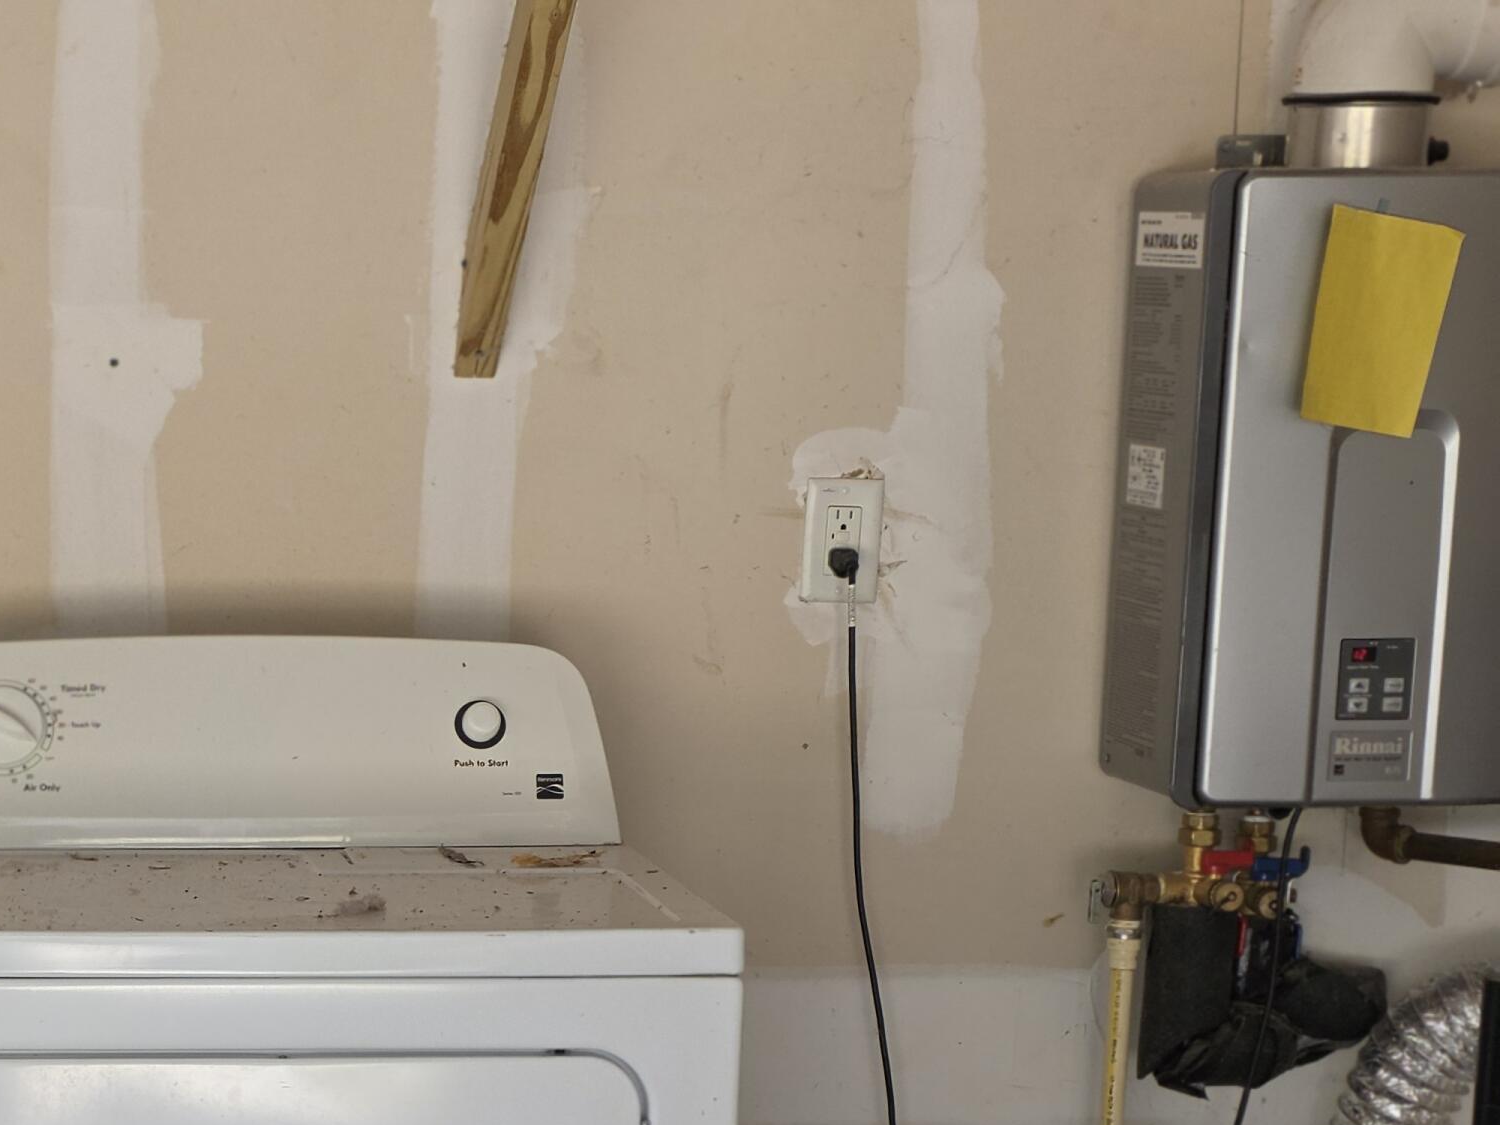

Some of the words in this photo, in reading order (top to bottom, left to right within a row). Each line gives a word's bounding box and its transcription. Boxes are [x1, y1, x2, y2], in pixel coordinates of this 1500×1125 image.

[1143, 233, 1179, 249] NATURAL
[1181, 233, 1199, 251] GAS
[90, 684, 106, 693] Dry
[1334, 738, 1403, 755] Rinnai
[454, 759, 474, 767] Push
[488, 759, 509, 767] Start
[23, 784, 37, 792] Air
[39, 784, 61, 793] Only
